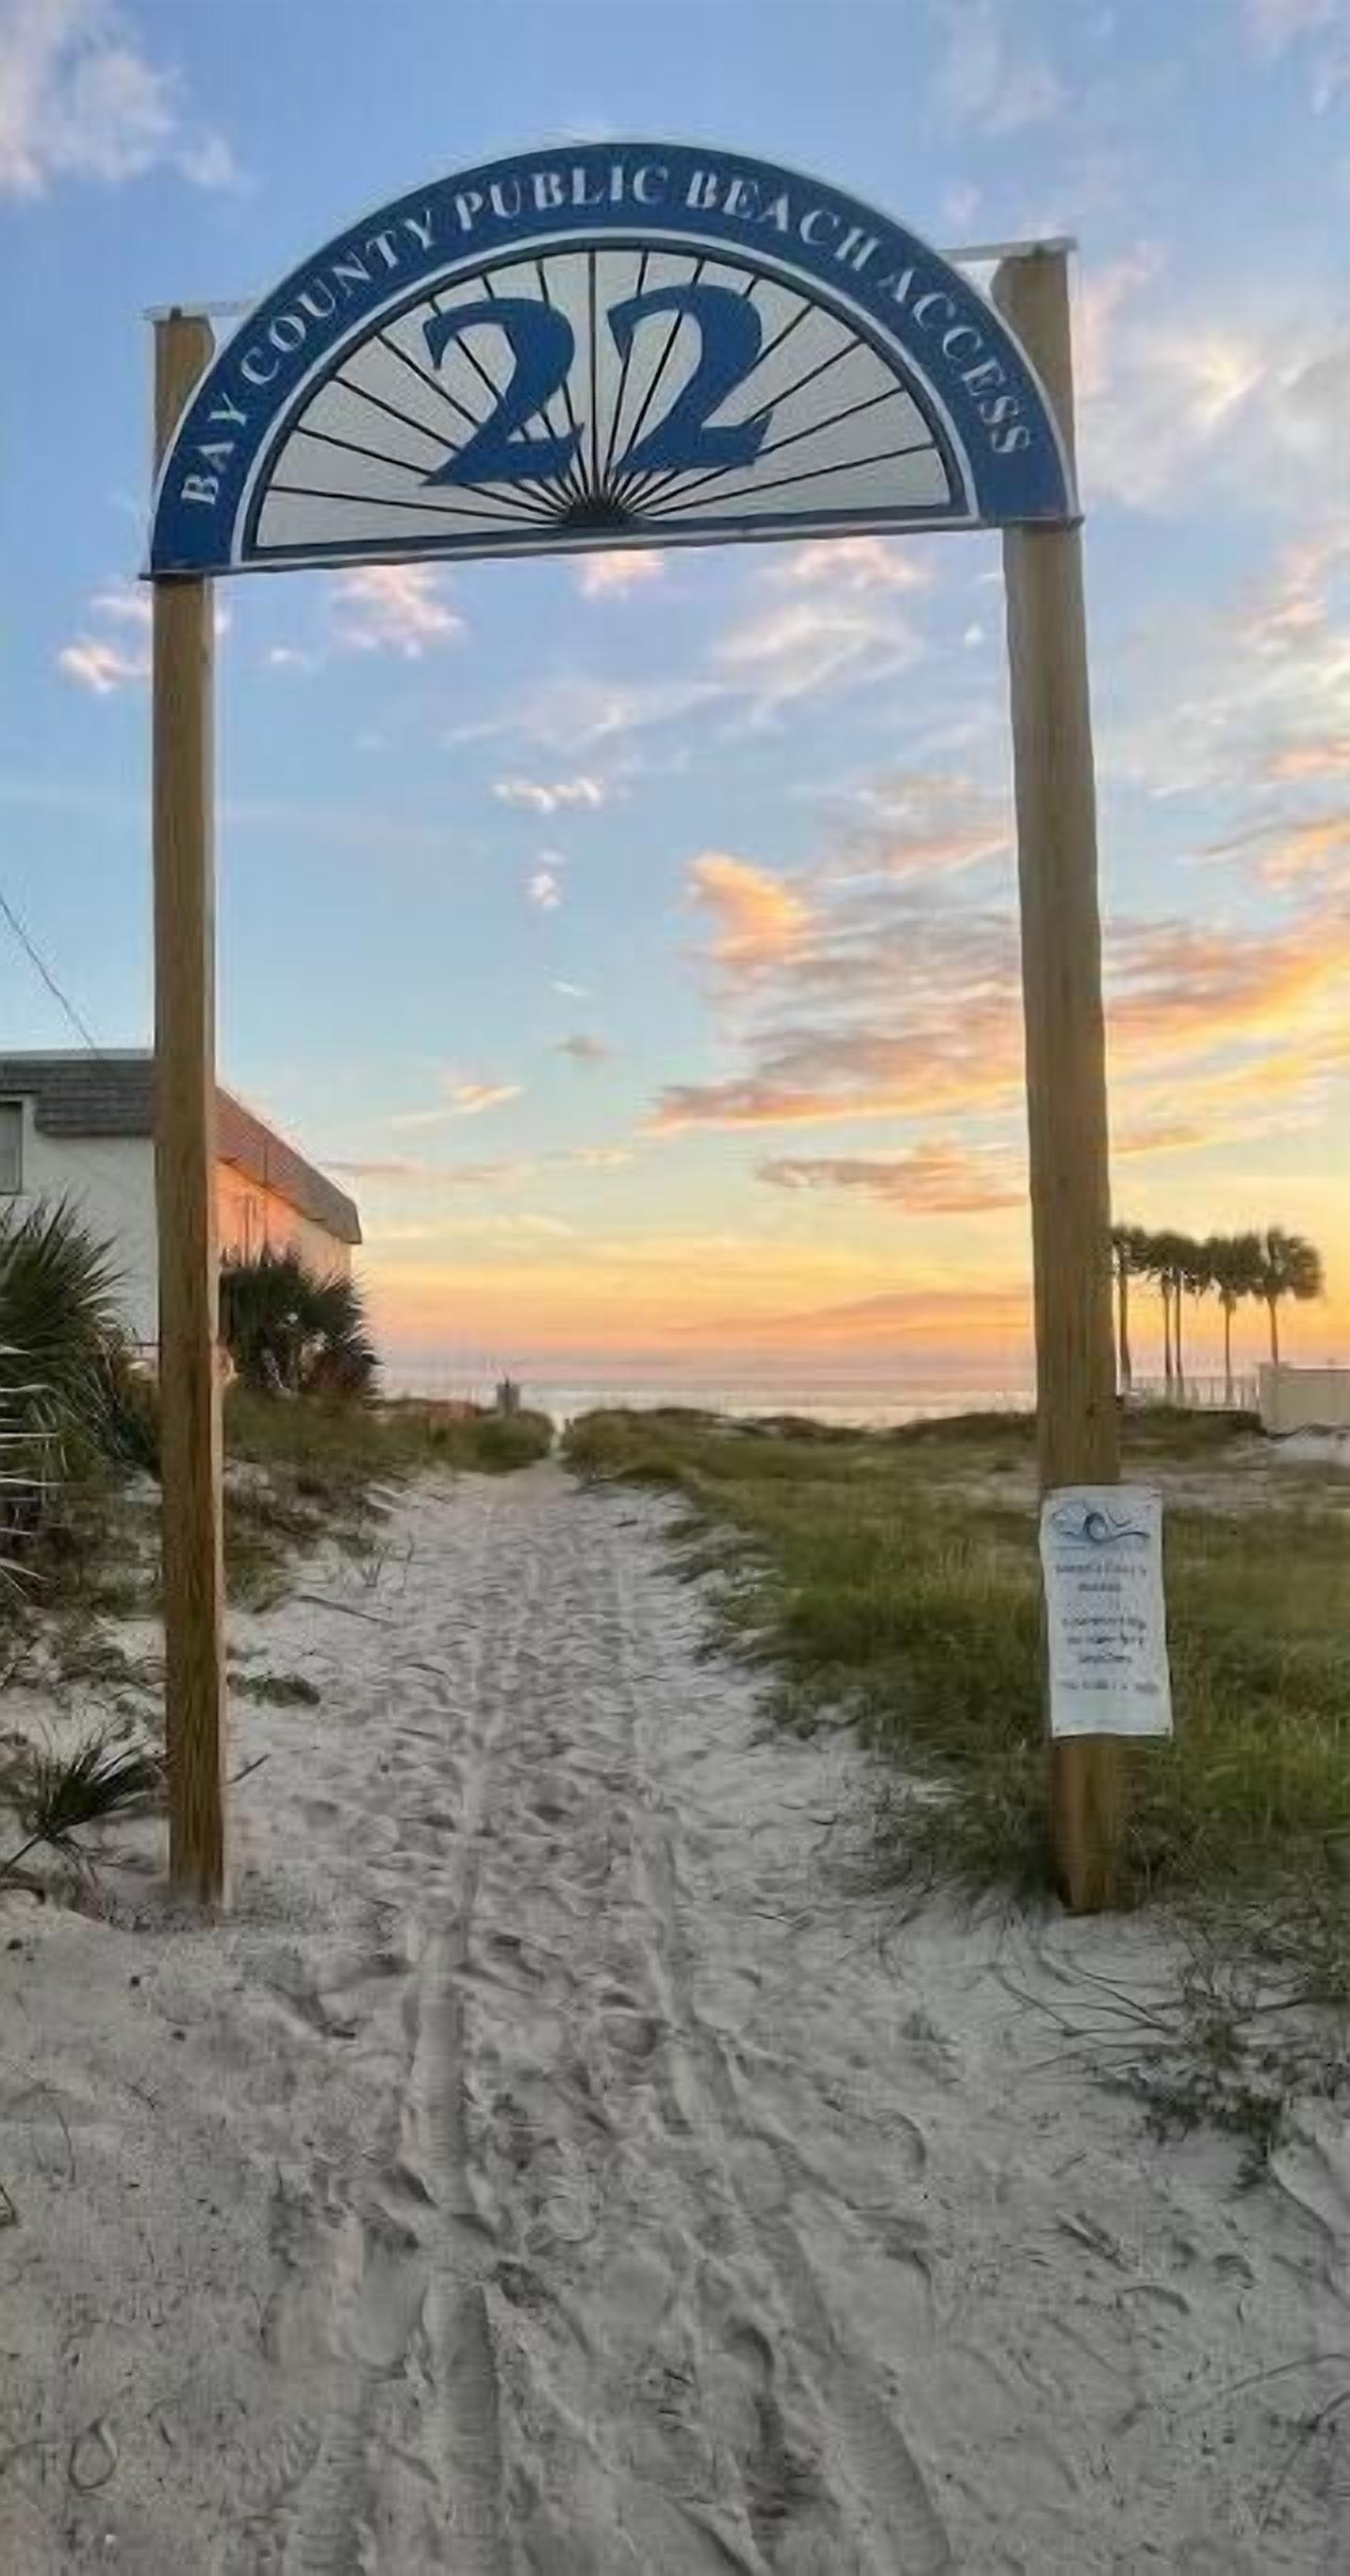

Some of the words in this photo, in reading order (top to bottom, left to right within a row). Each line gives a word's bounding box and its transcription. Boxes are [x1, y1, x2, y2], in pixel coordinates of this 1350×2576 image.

[180, 392, 249, 506] BAY
[240, 209, 435, 386] COUNTY
[454, 165, 669, 231] PUBLIC
[684, 170, 881, 272] BEACH
[881, 266, 1030, 454] ACCESS
[419, 285, 773, 486] 22
